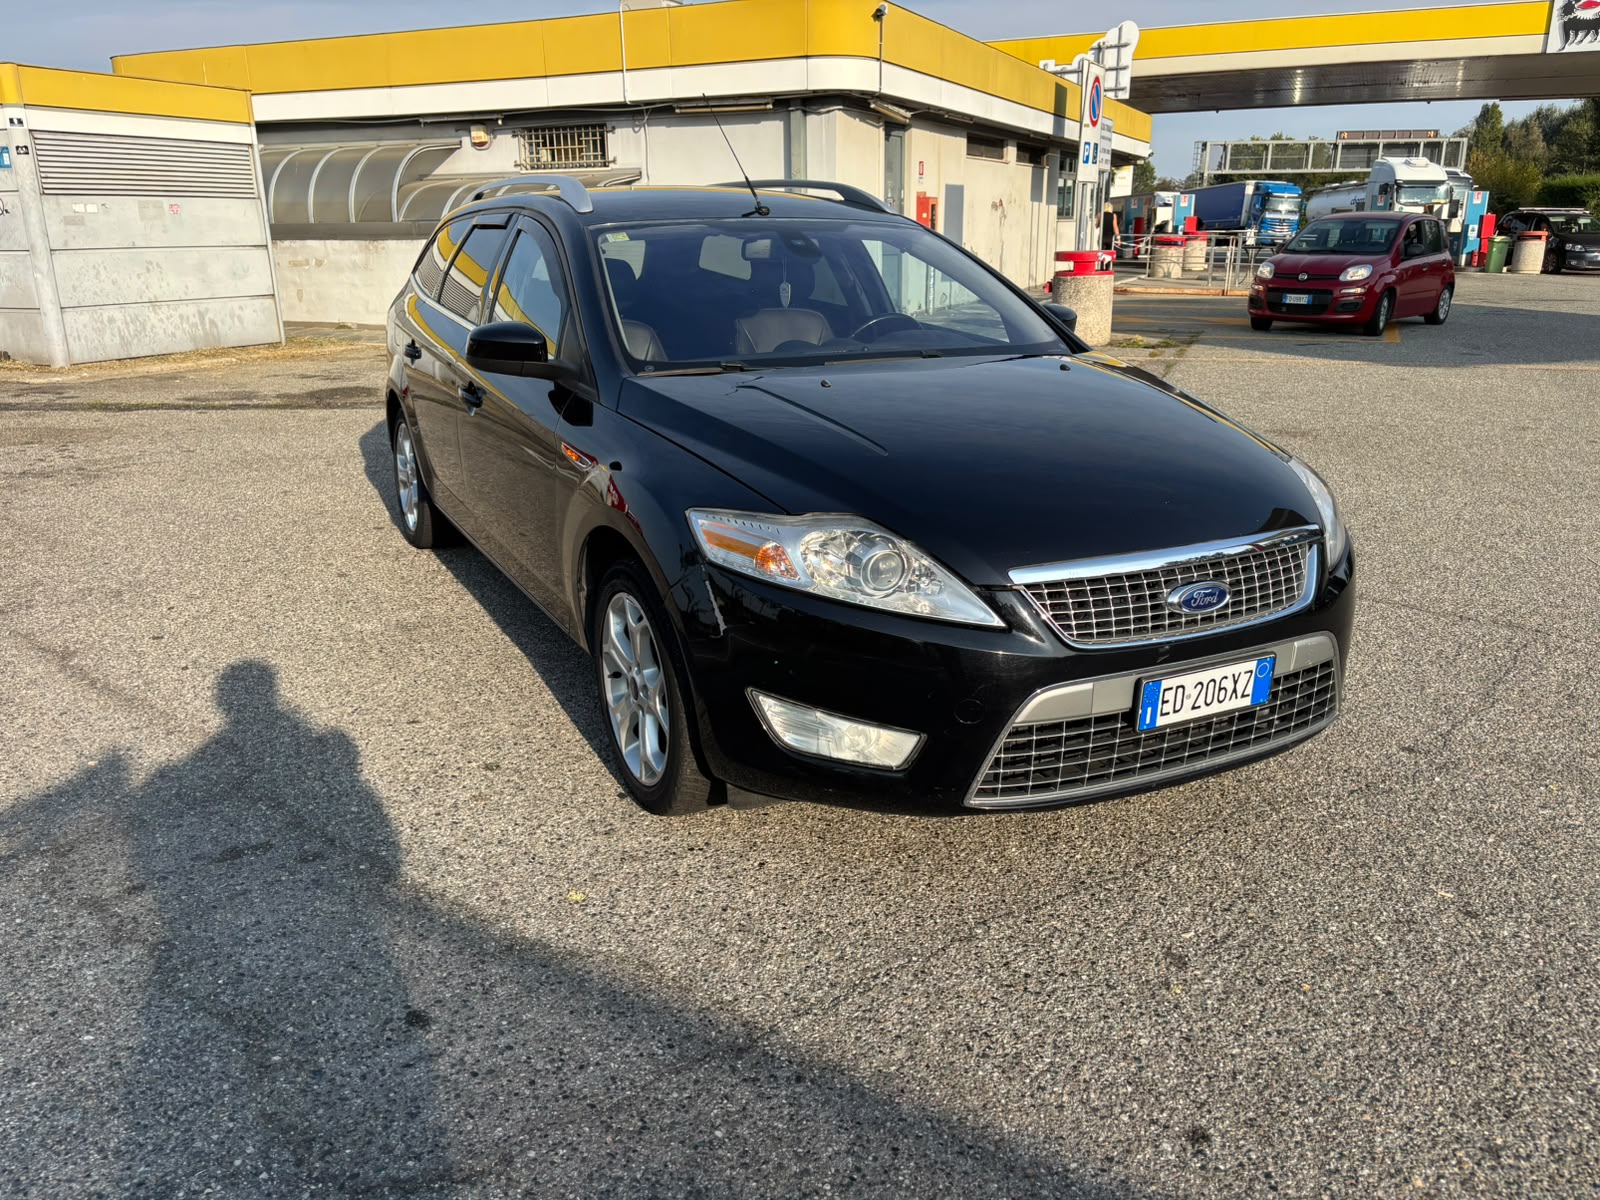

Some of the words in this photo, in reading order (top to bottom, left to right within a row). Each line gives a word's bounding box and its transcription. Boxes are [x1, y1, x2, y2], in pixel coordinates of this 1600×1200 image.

[1191, 589, 1218, 607] Ford
[1160, 684, 1186, 717] ED
[1191, 669, 1254, 711] 206XZ
